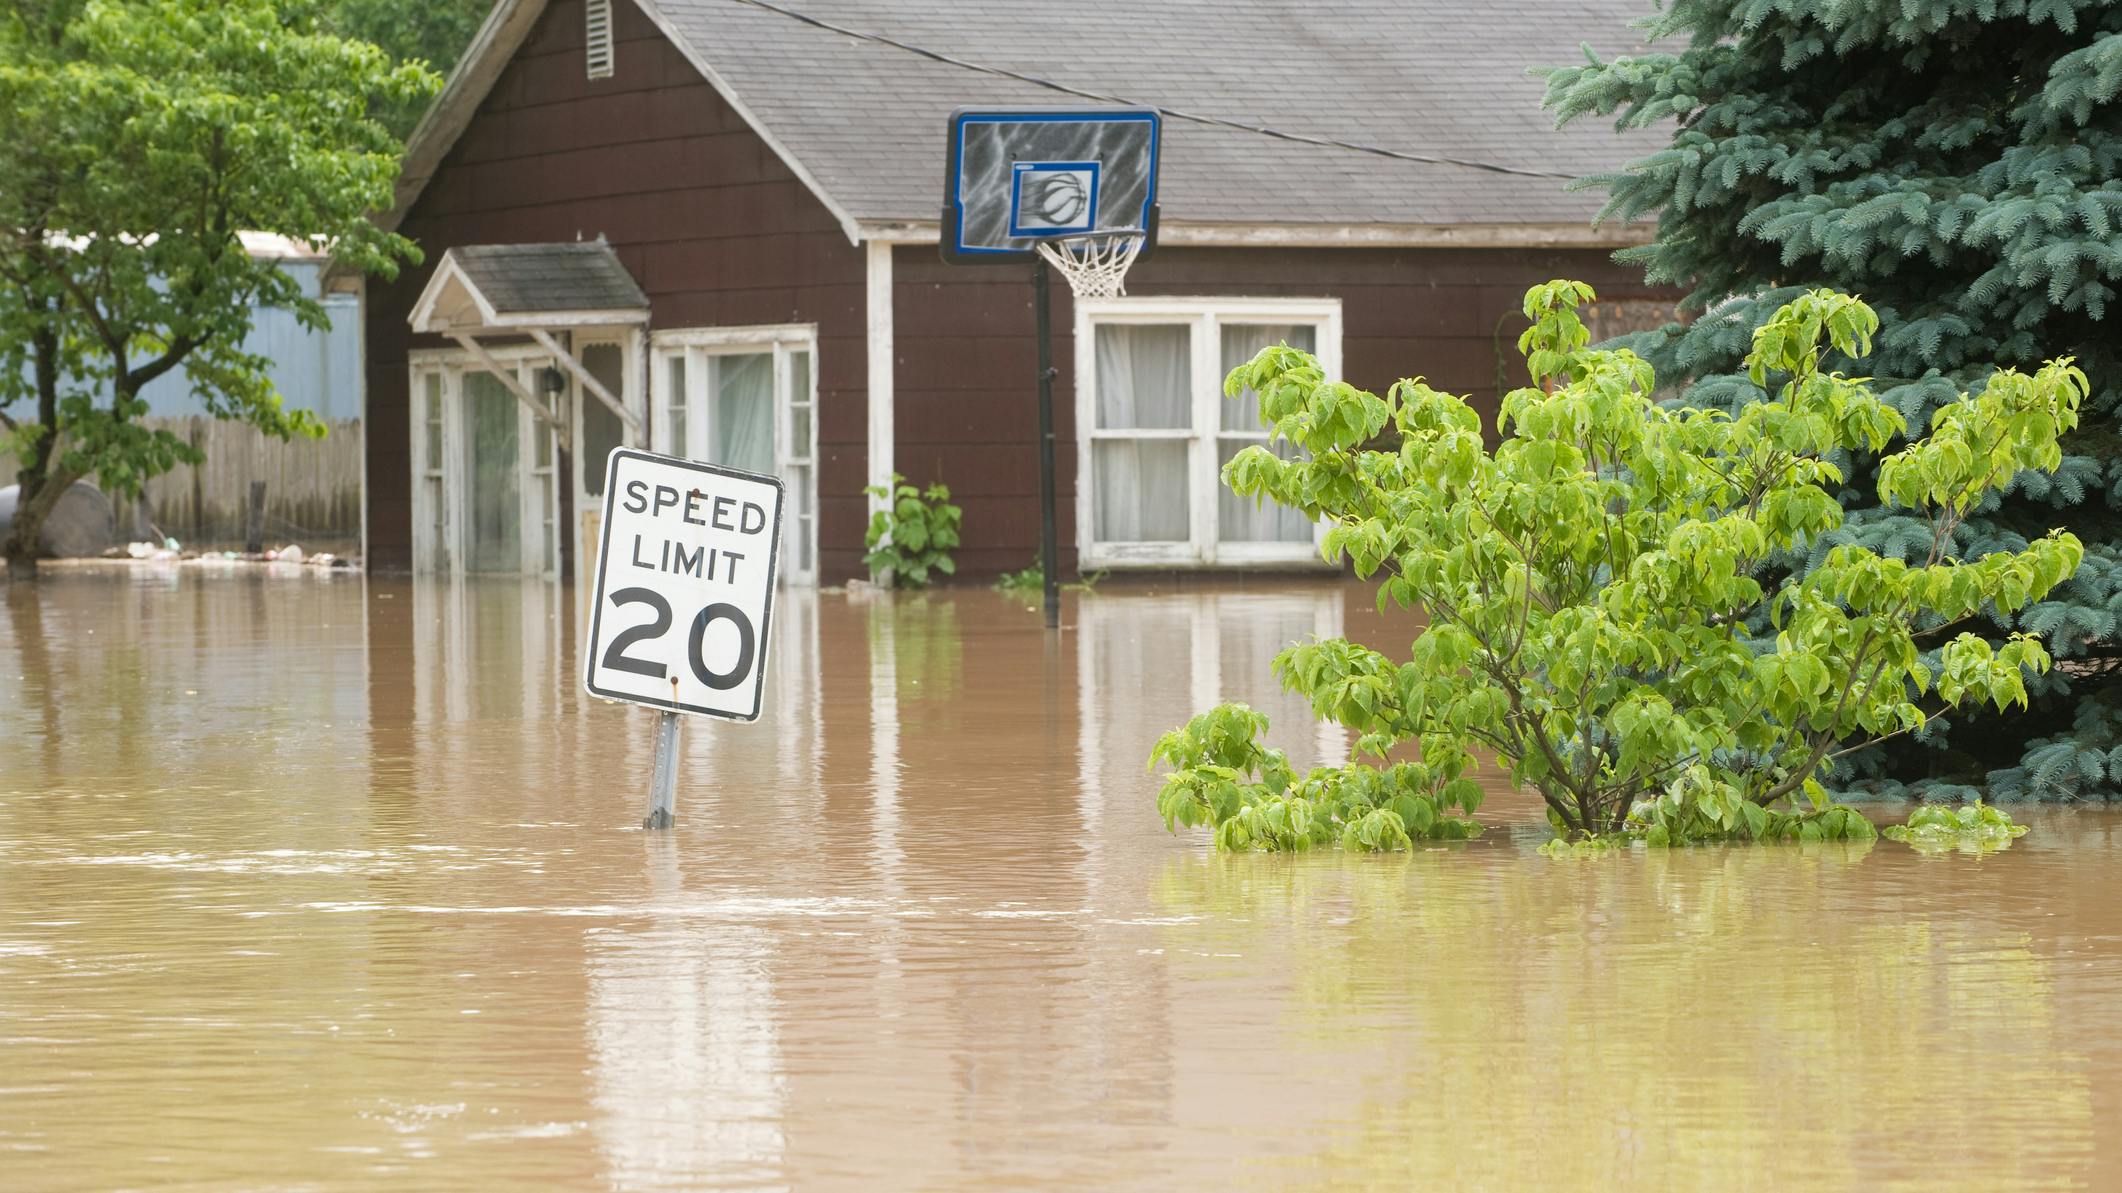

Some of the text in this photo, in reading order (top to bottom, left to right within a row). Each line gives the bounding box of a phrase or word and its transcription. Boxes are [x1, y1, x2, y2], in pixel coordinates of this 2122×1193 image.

[623, 480, 766, 535] SPEED
[632, 534, 745, 584] LIMIT
[601, 587, 755, 690] 20
